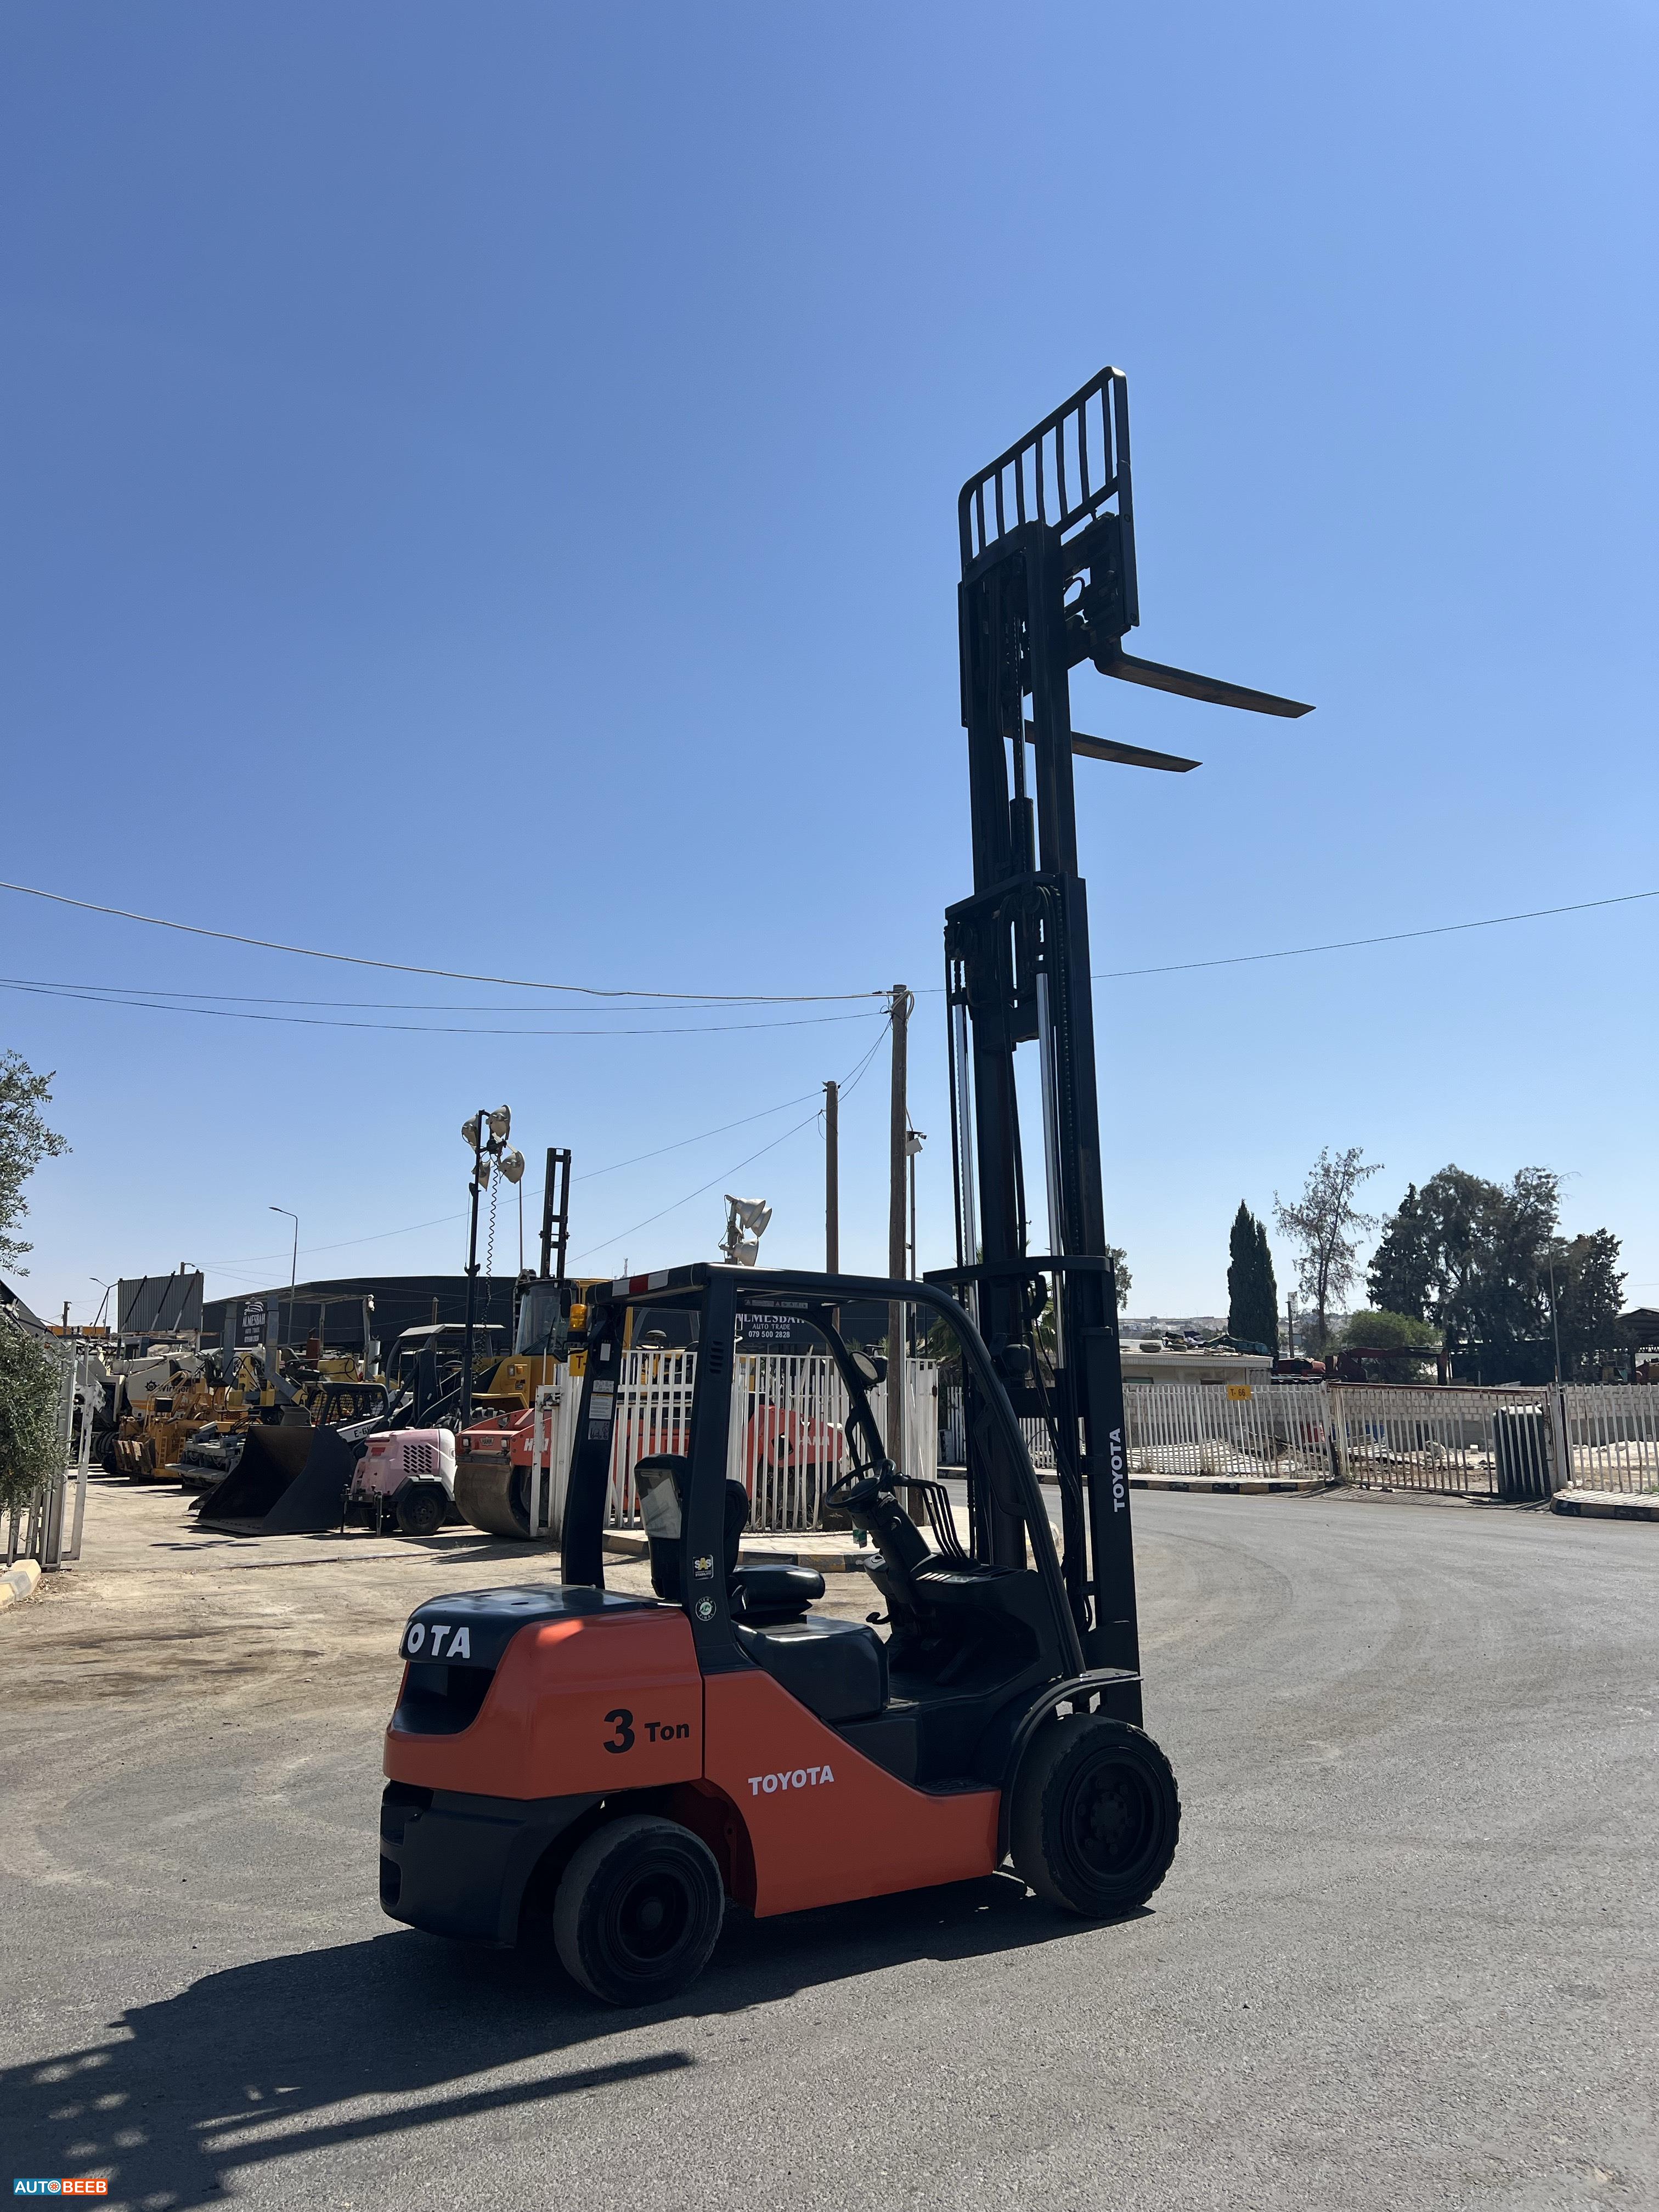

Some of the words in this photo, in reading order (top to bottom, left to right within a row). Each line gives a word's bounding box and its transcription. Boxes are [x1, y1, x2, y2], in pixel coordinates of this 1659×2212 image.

[1238, 1389, 1245, 1397] 66
[1109, 1428, 1125, 1513] TOYOTA
[695, 1558, 712, 1570] SAS
[407, 1622, 470, 1658] OTA
[603, 1709, 635, 1753] 3
[645, 1722, 690, 1742] Ton
[748, 1765, 834, 1796] TOYOTA
